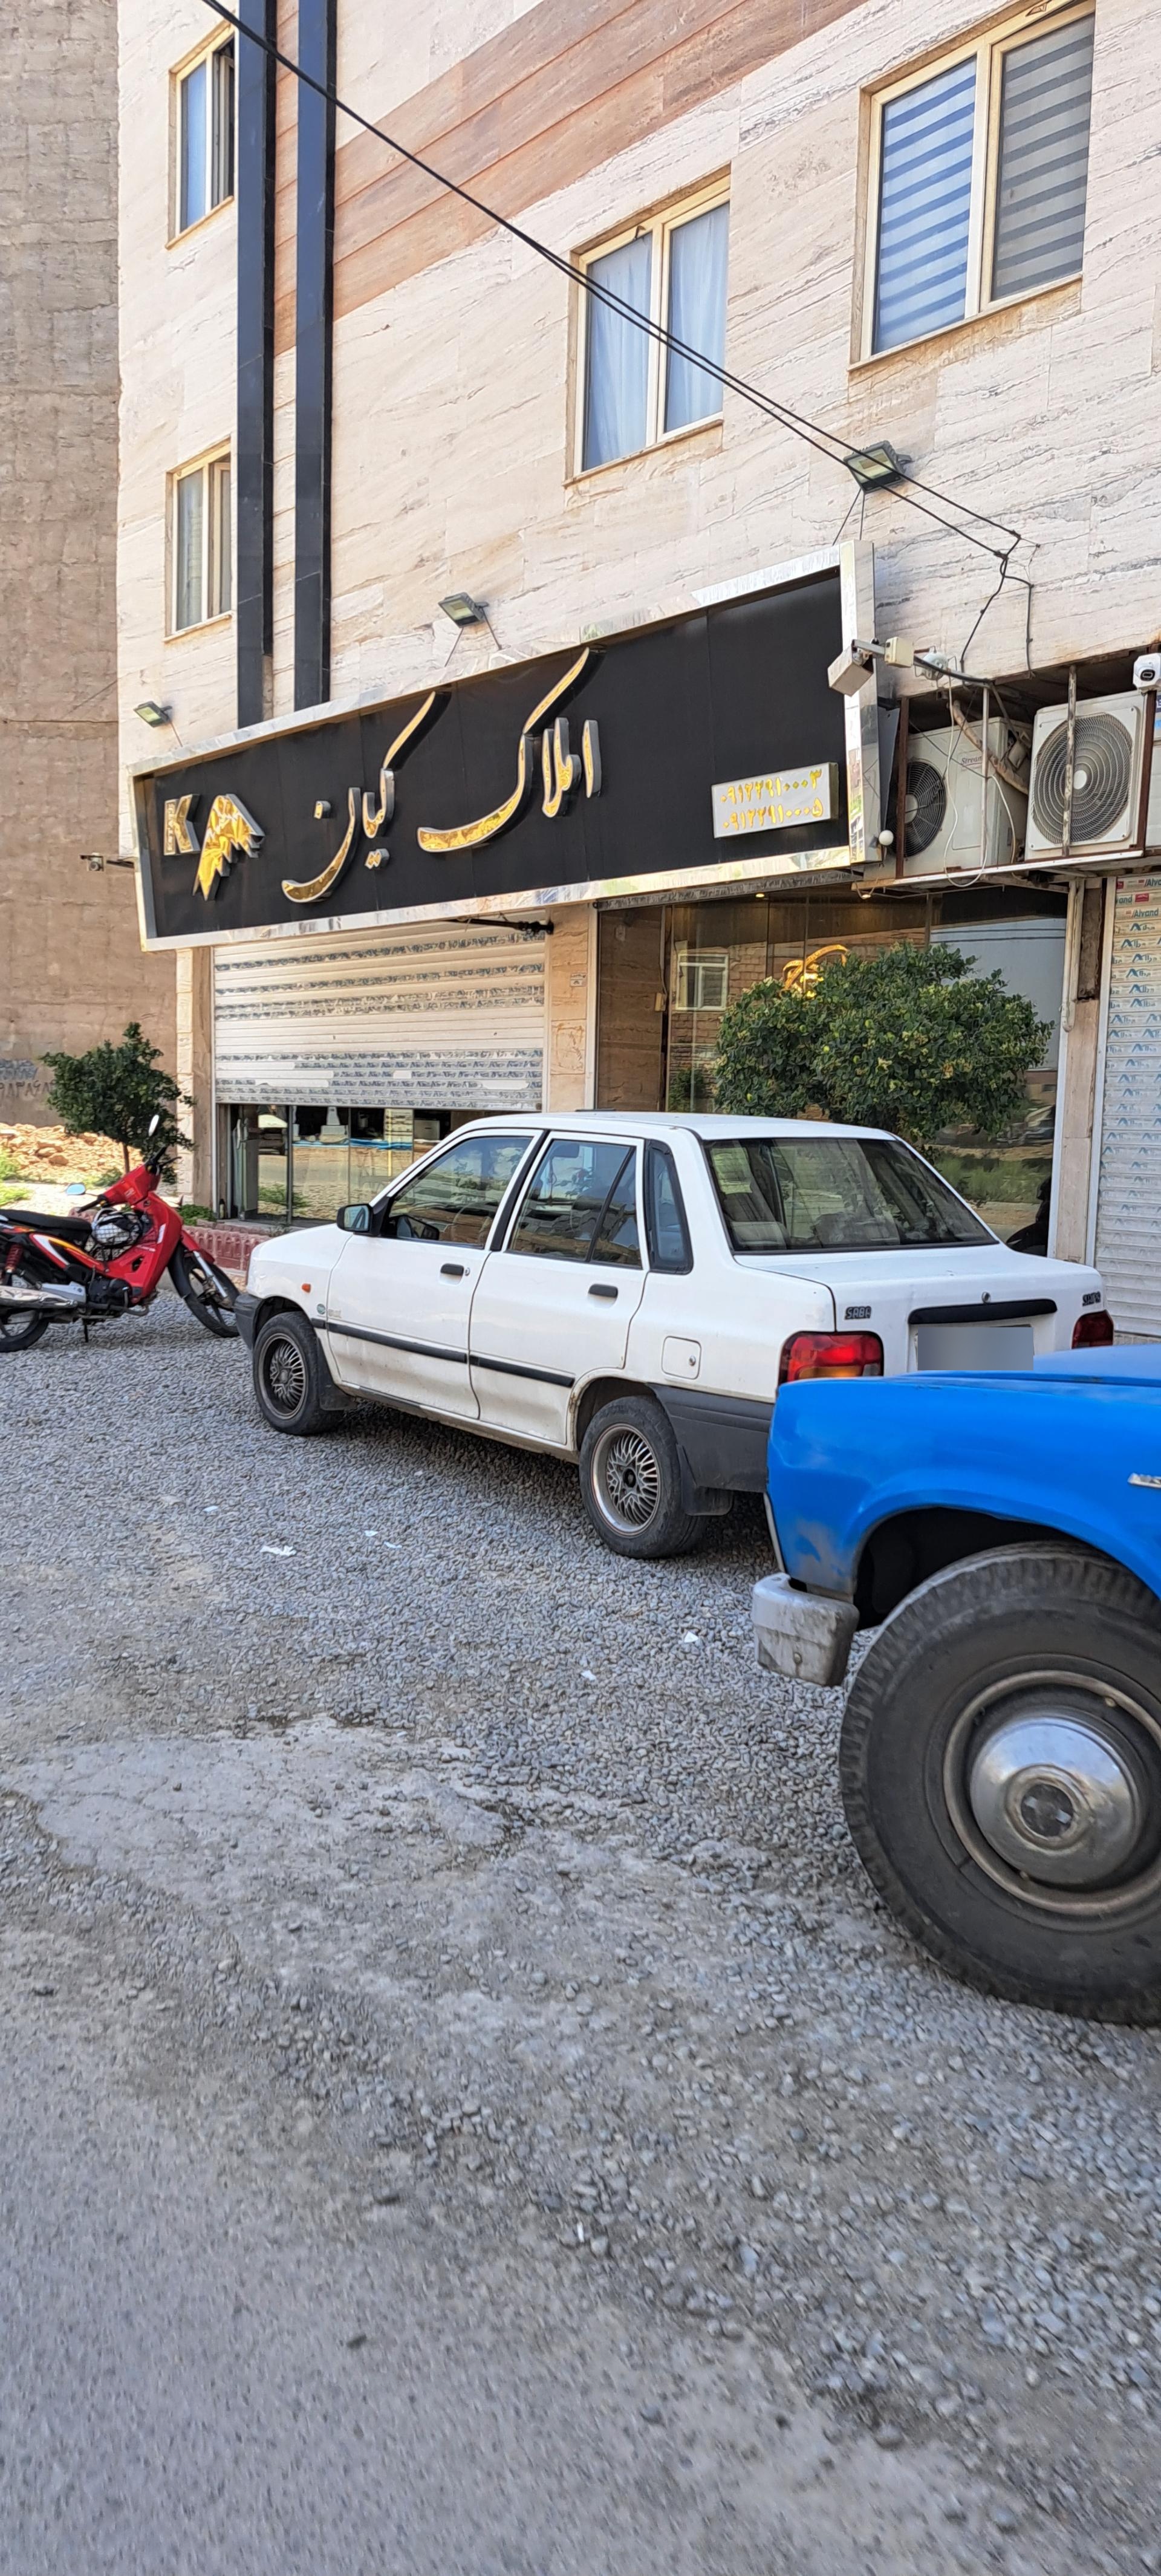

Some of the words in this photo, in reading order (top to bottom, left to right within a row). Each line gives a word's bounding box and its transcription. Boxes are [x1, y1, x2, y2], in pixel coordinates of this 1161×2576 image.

[281, 691, 439, 903] کیان
[417, 646, 602, 853] املاک
[845, 1306, 871, 1319] SABA
